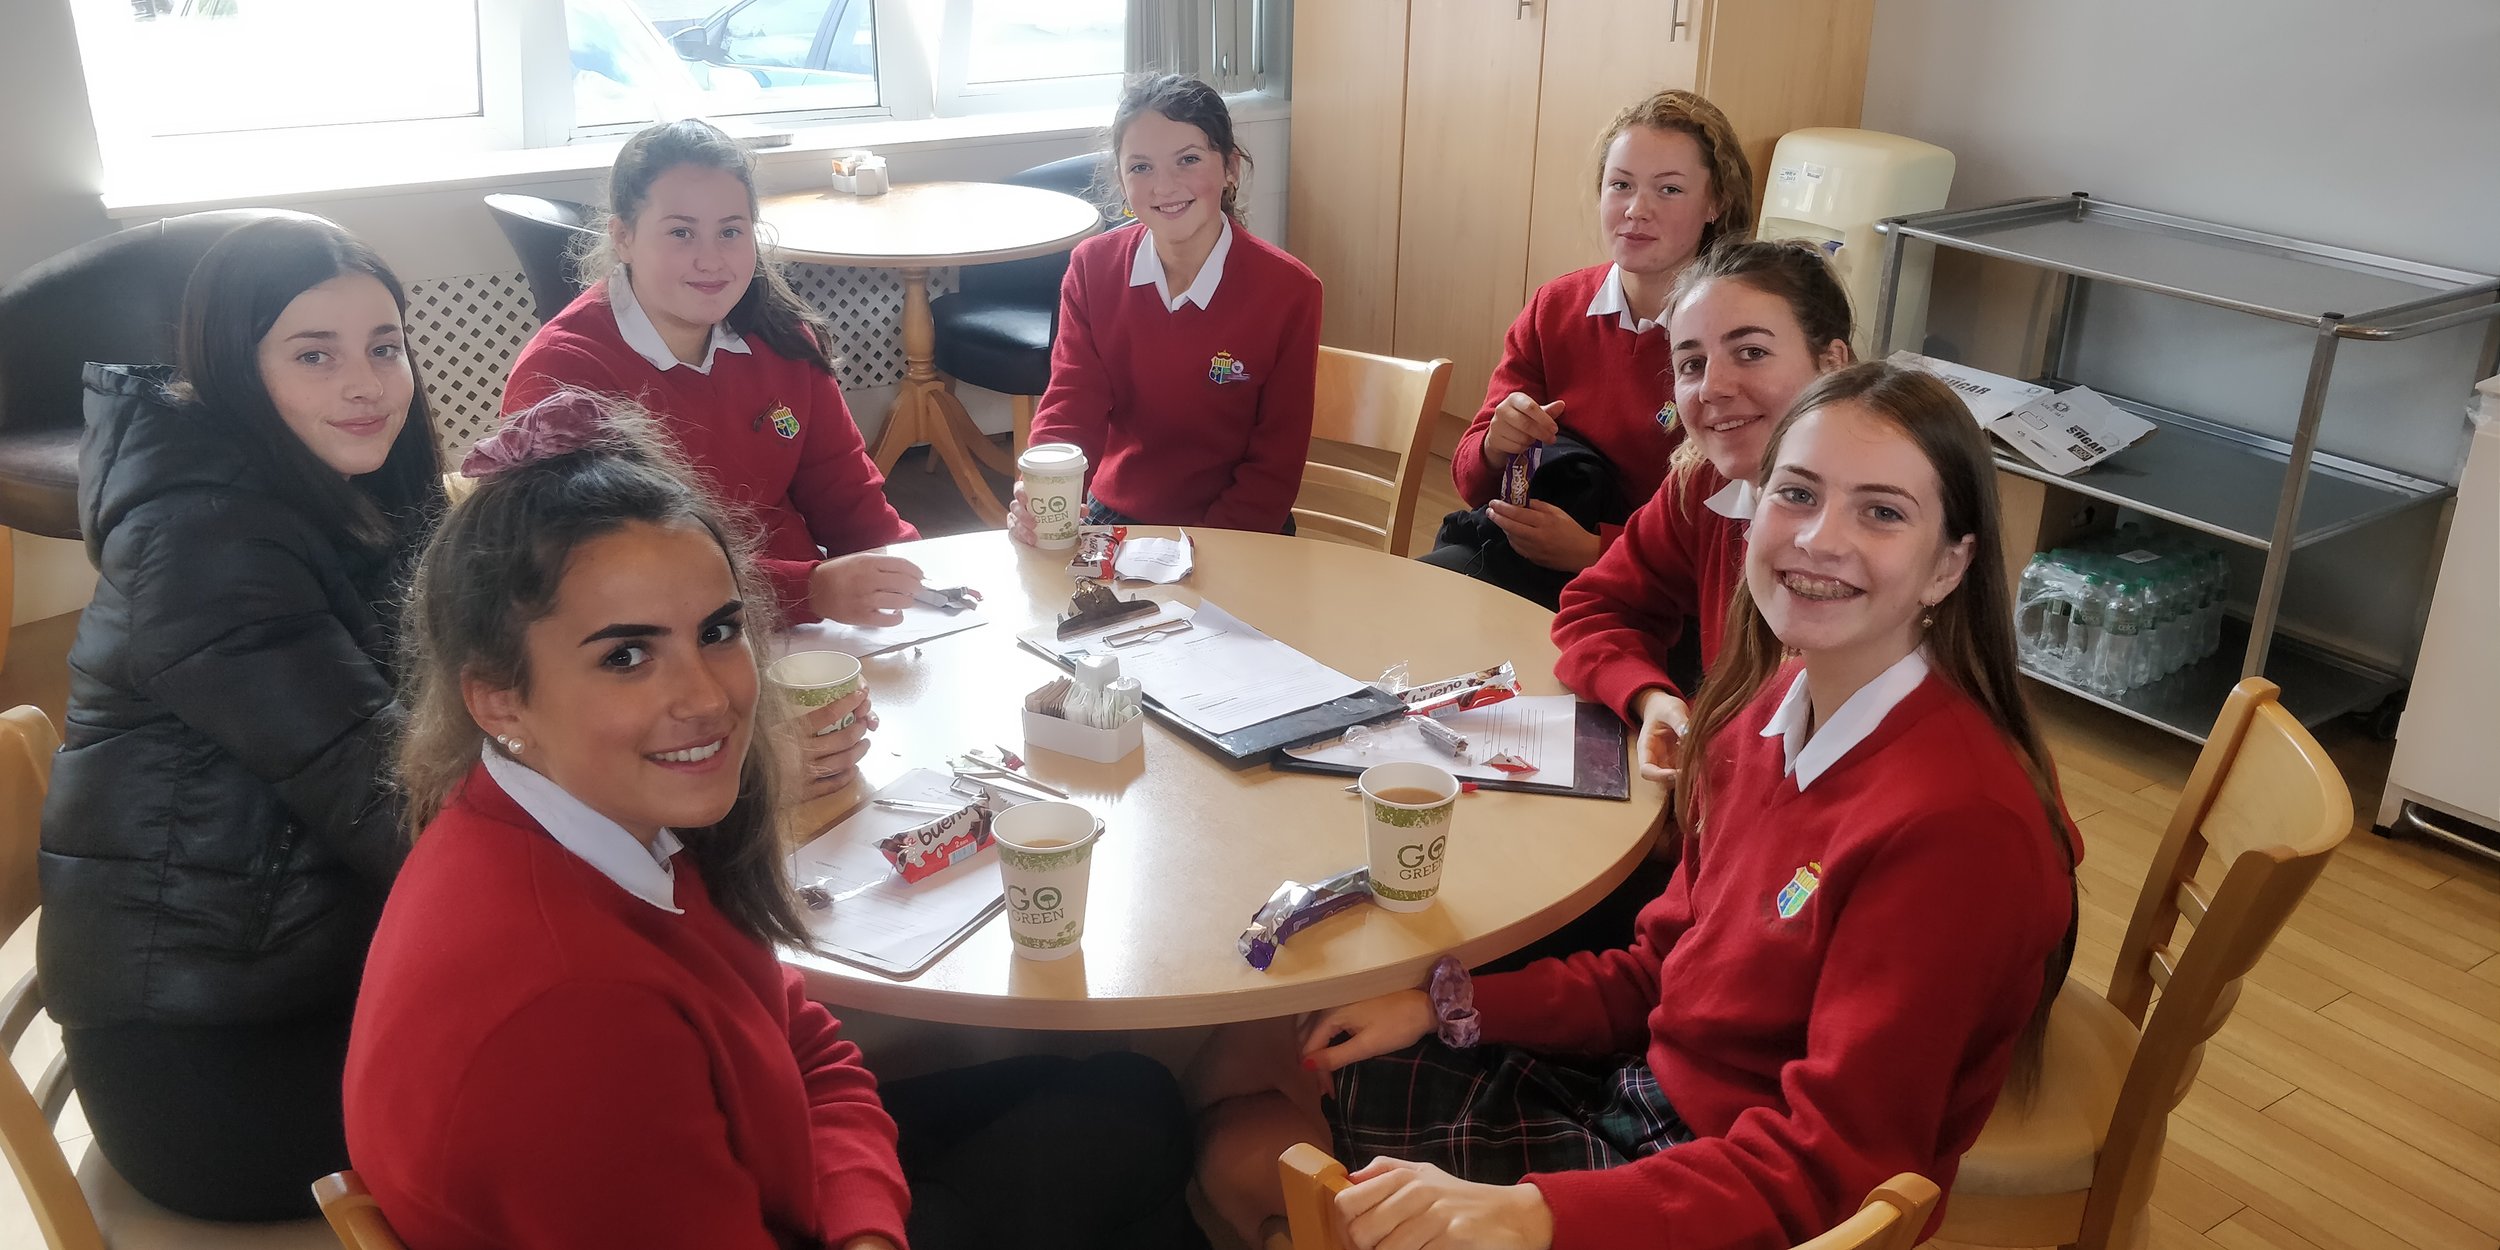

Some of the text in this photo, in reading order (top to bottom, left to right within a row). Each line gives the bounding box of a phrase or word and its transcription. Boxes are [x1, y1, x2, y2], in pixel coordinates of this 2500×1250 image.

[2066, 426, 2107, 454] SUGAR
[1031, 496, 1067, 515] GO
[1035, 511, 1069, 524] GREEN
[1411, 681, 1462, 703] bueno
[1397, 834, 1446, 869] GO
[1400, 857, 1444, 880] GREEN
[1008, 884, 1062, 911] GO
[1011, 908, 1064, 925] GREEN
